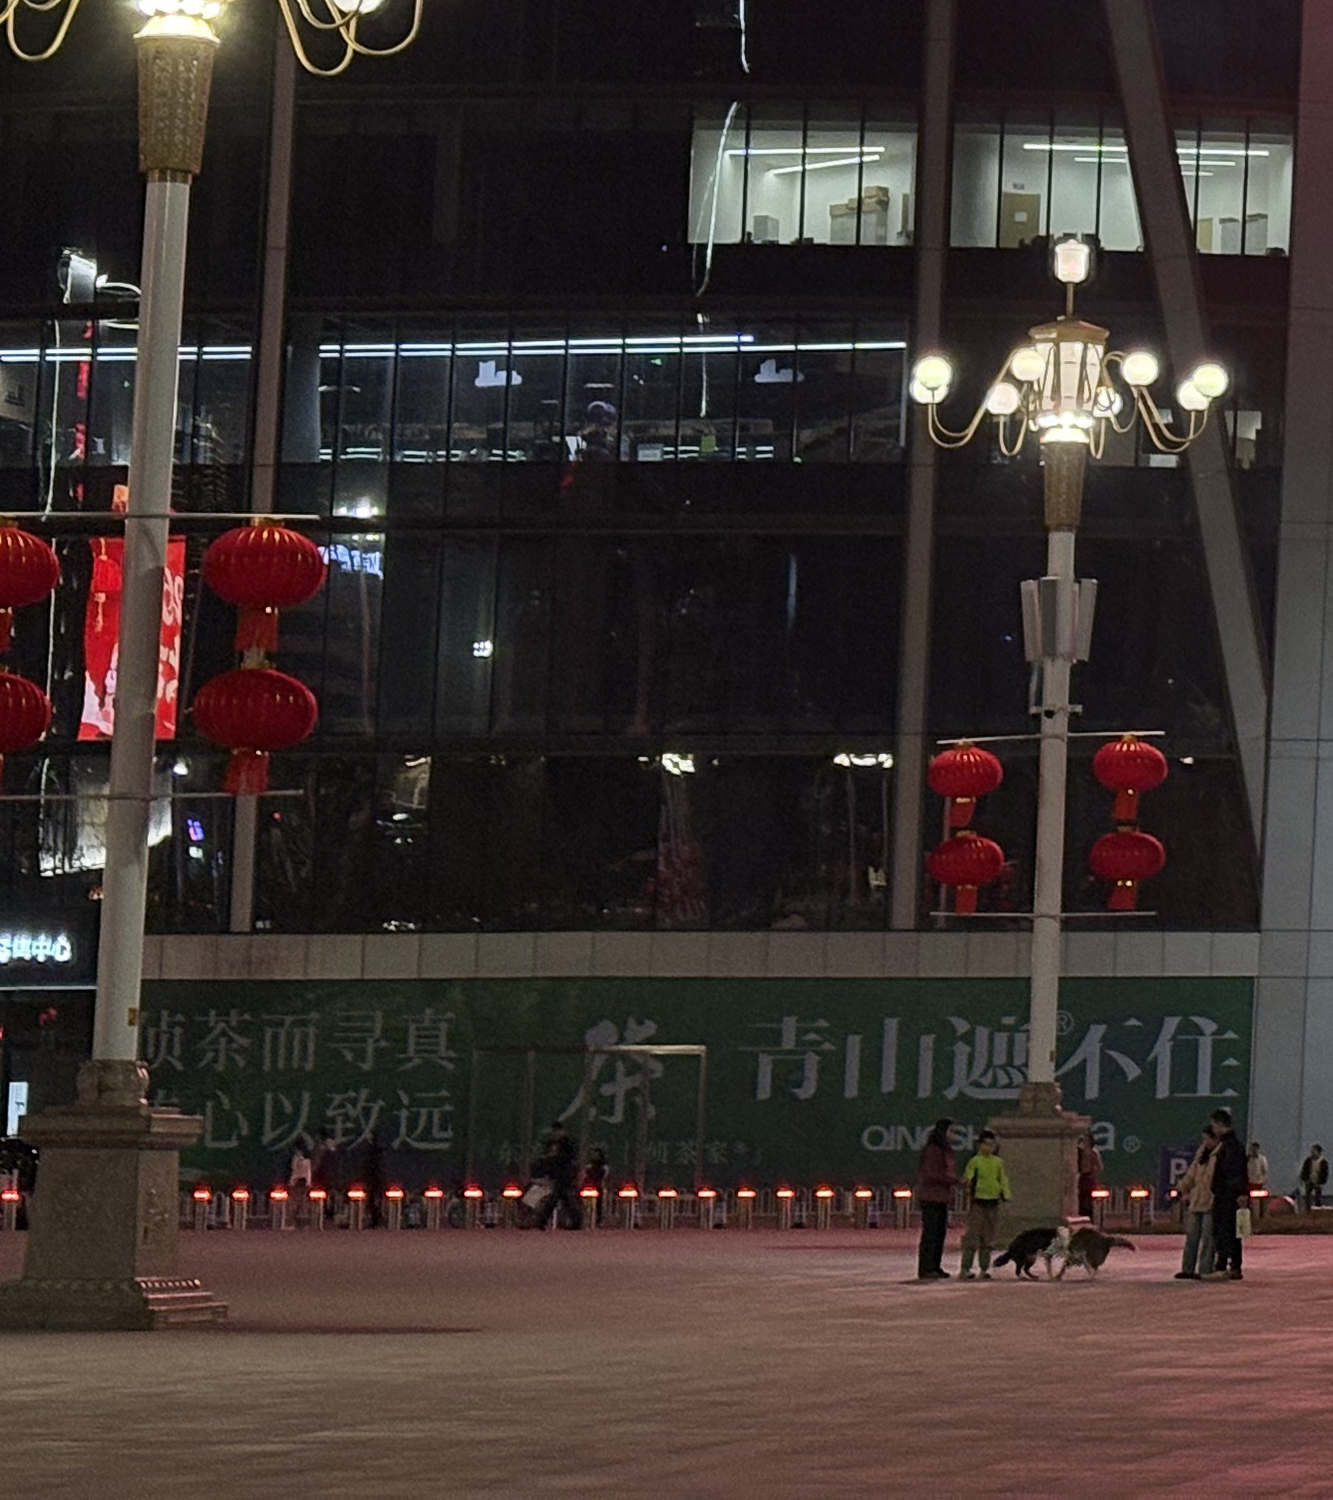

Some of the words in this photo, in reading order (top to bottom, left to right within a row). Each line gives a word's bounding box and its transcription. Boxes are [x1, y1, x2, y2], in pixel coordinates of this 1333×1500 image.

[738, 1015, 1241, 1101] 青山遮不住
[154, 1088, 455, 1151] 心以致远
[1169, 1157, 1188, 1185] P
